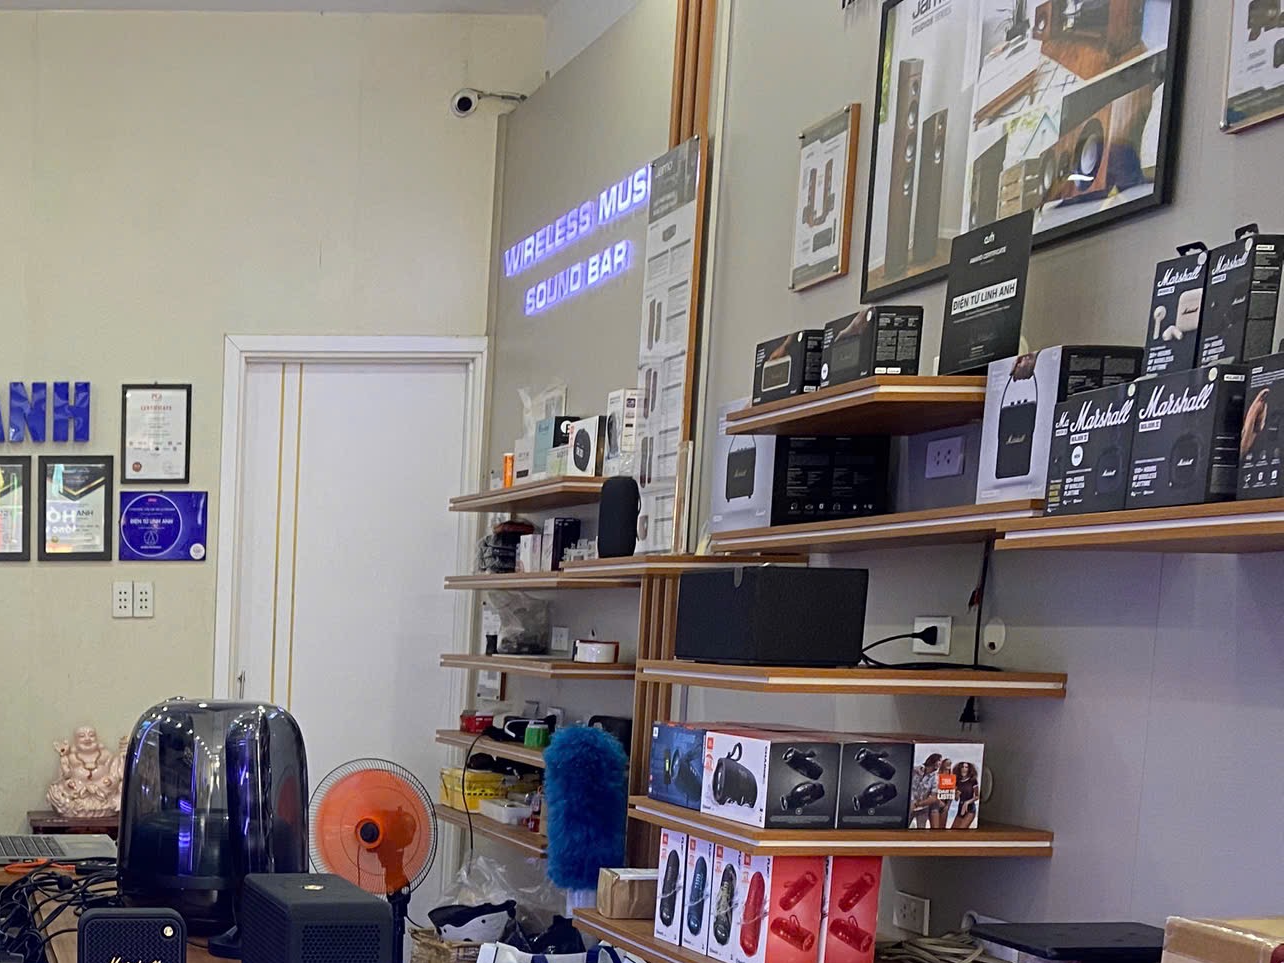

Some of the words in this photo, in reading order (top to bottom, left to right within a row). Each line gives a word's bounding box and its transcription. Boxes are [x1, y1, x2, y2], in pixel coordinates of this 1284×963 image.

[504, 201, 592, 277] WIRELESS
[524, 262, 581, 317] SOUND
[587, 240, 629, 285] BAR
[1157, 267, 1203, 288] Marshall
[1211, 252, 1250, 275] Marshall
[981, 287, 998, 302] LINH
[998, 282, 1016, 296] ANH
[1070, 399, 1135, 433] Marshall
[1138, 383, 1215, 421] Marshall
